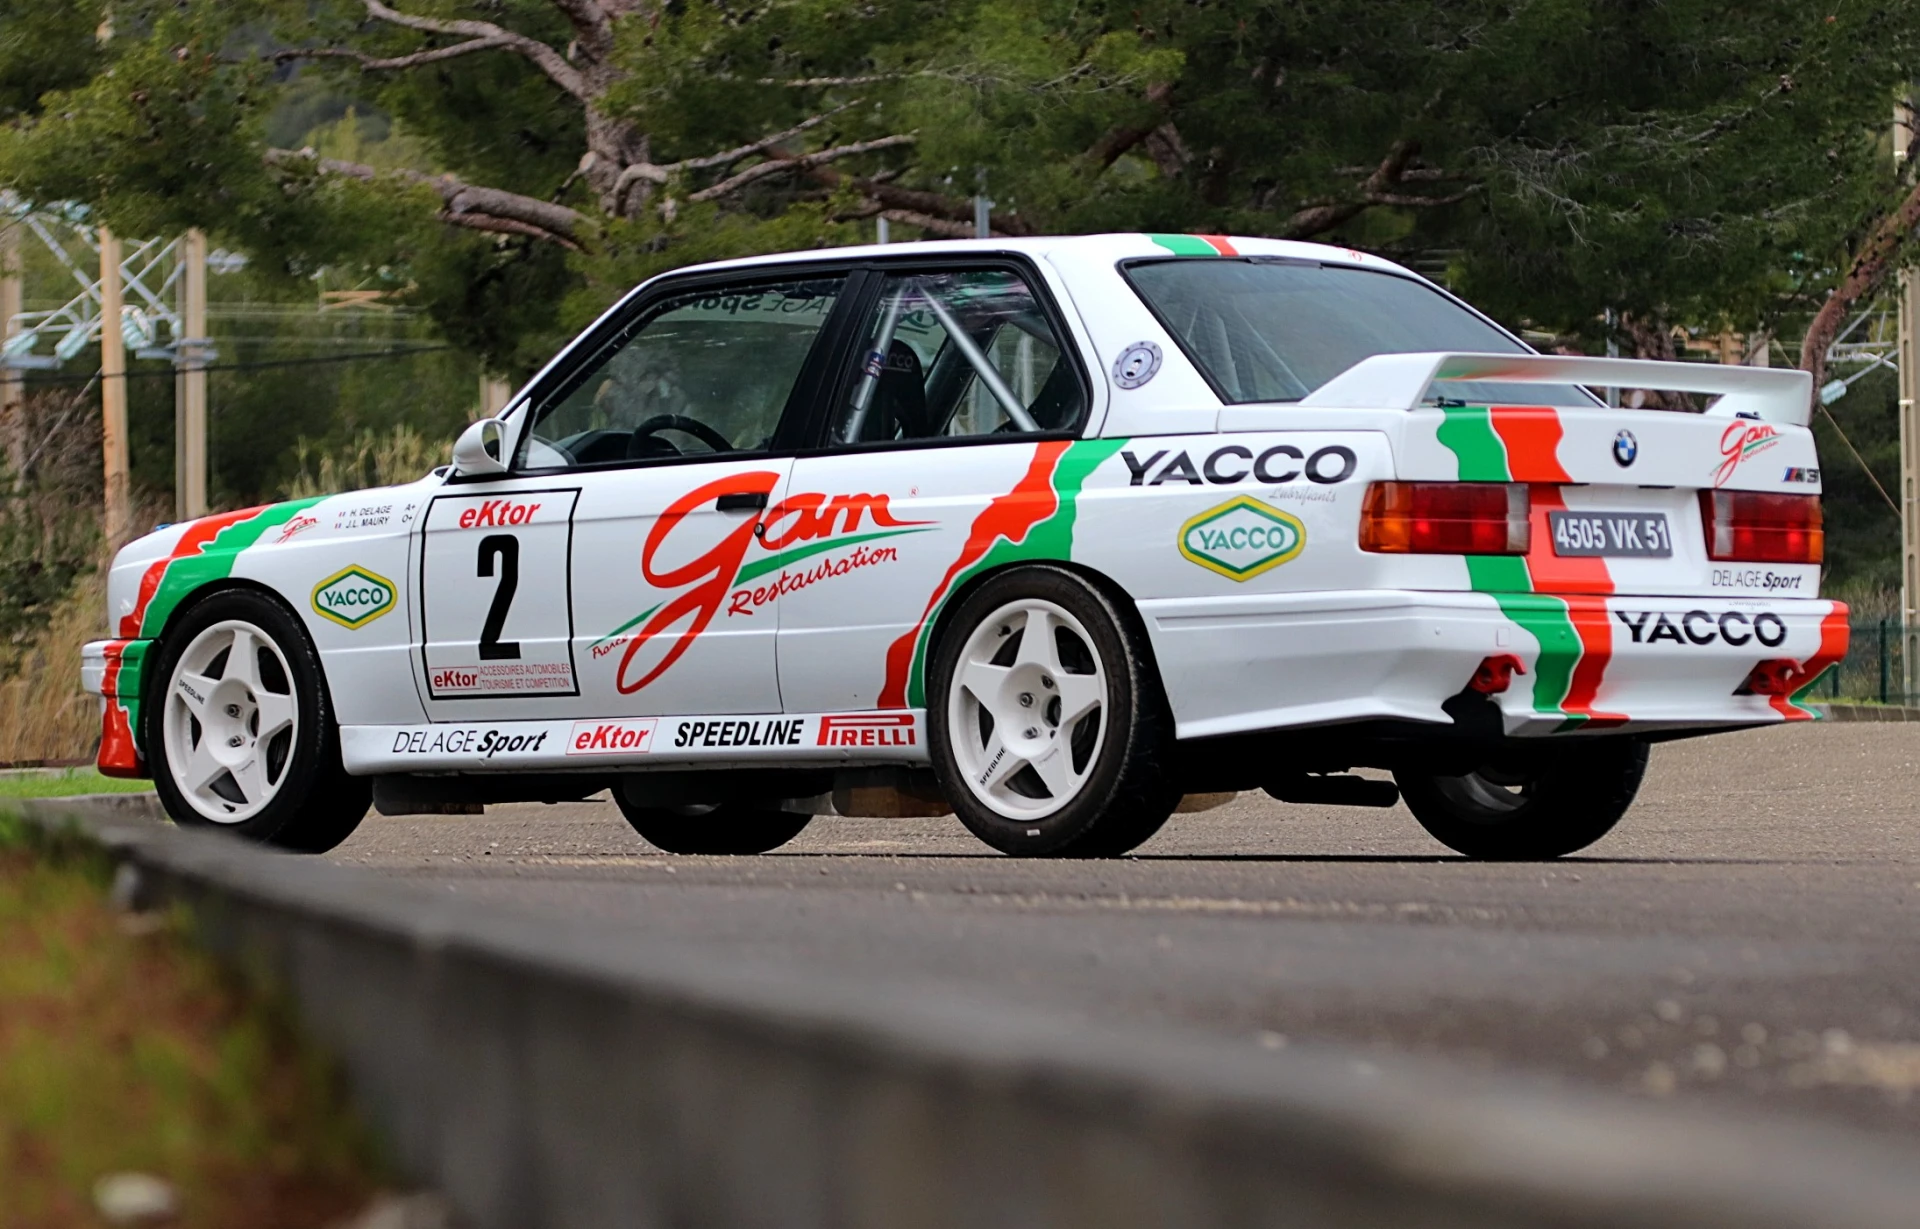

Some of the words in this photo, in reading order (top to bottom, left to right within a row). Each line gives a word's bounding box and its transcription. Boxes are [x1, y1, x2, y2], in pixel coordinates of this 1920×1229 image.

[1120, 445, 1358, 486] YACCO
[359, 505, 393, 517] DELAGE
[361, 516, 390, 527] MAURY
[459, 501, 541, 529] eKtor
[1198, 526, 1286, 550] YACCO
[1556, 518, 1607, 549] 4505
[1607, 519, 1643, 549] VK
[1645, 520, 1670, 550] 51
[728, 546, 897, 617] Restauration
[1712, 569, 1762, 588] DELAGE
[1763, 571, 1802, 592] Sport
[324, 587, 384, 607] YACCO
[477, 534, 521, 660] 2
[1615, 610, 1788, 648] YACCO
[434, 670, 478, 687] eKtor
[479, 664, 525, 676] ACCESSOIRES
[525, 663, 571, 675] AUTOMOBILES
[481, 678, 515, 690] TOURISME
[515, 678, 524, 689] ET
[525, 677, 570, 688] COMPETITION
[391, 730, 477, 753] DELAGE
[477, 729, 549, 758] Sport
[574, 724, 650, 750] eKtor
[674, 718, 805, 747] SPEEDLINE
[816, 713, 917, 746] PIRELLI
[979, 746, 1006, 787] SPEEDLINE
